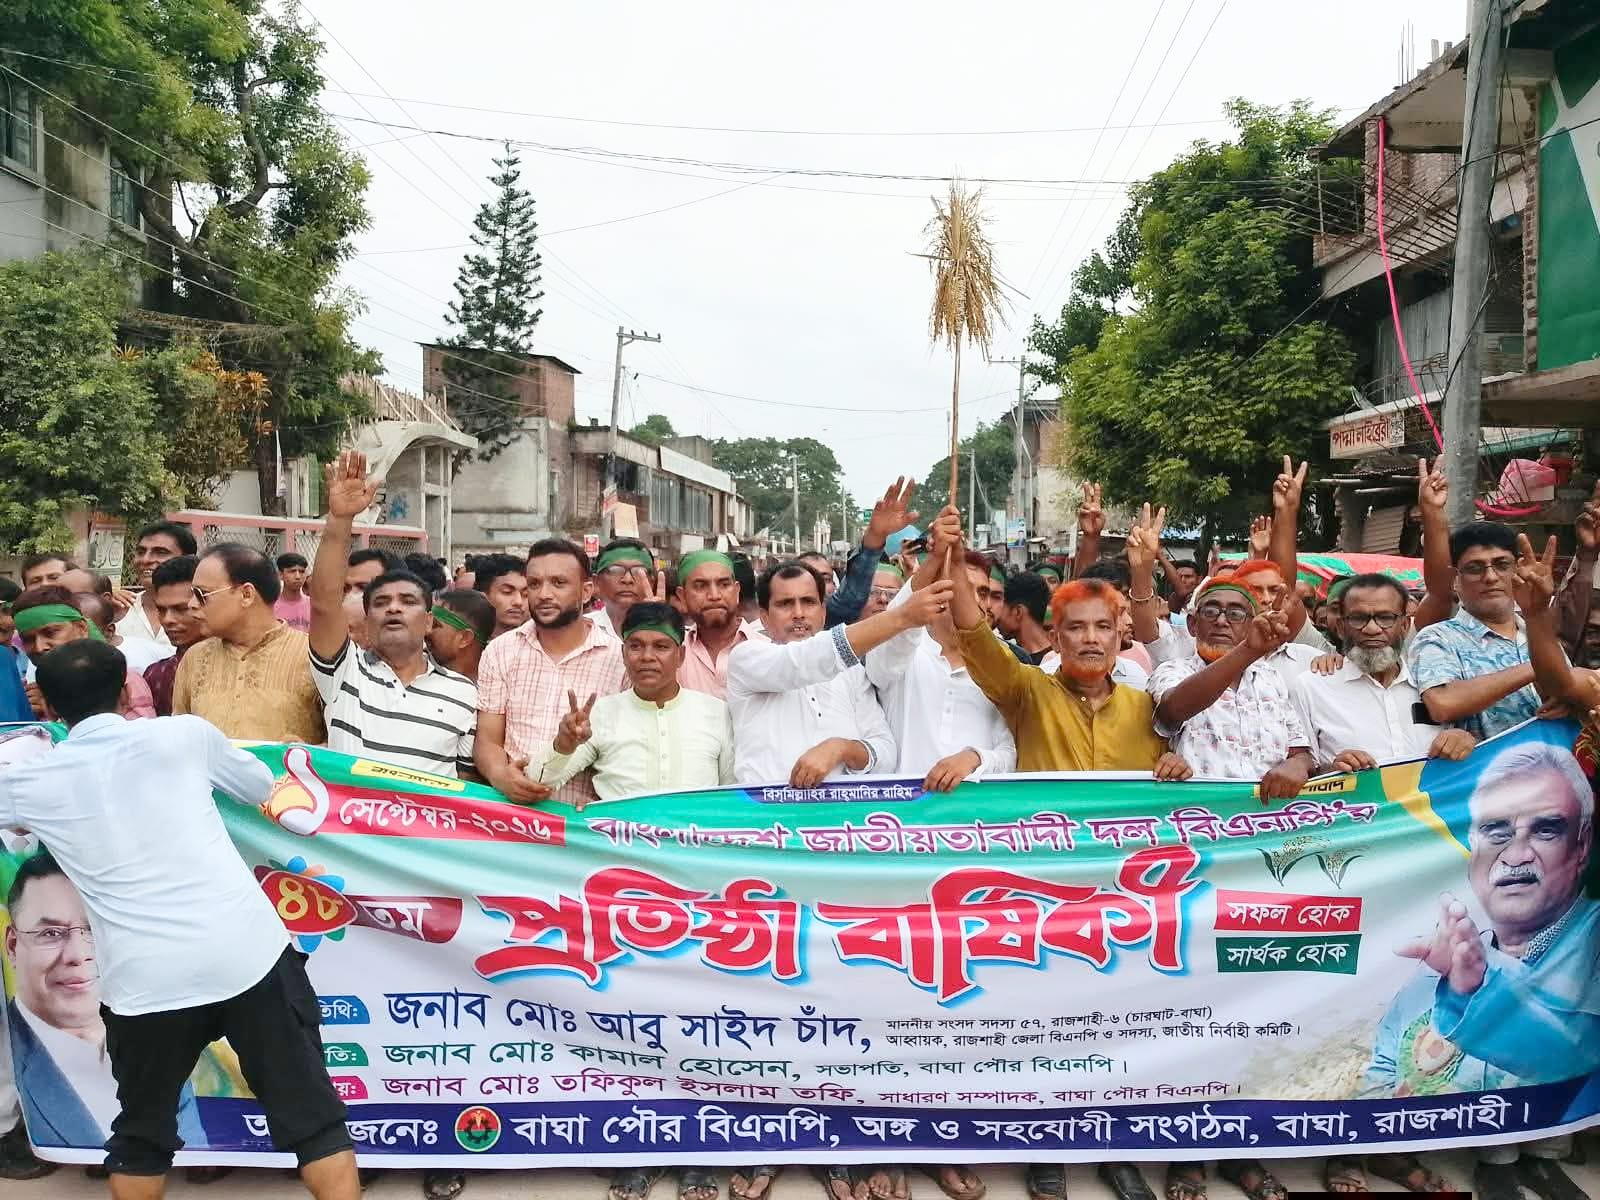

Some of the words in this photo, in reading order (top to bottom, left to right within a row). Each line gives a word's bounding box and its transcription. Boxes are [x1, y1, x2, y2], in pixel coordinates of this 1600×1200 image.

[798, 811, 1080, 854] জাতীয়তাবাদী
[1085, 816, 1160, 848] দল
[472, 866, 803, 986] প্রতিষ্ঠা
[1226, 902, 1292, 925] সফল
[1298, 903, 1355, 927] হোক
[1226, 940, 1292, 967] সার্থক
[1296, 942, 1350, 966] হোক
[384, 987, 492, 1029] জনাব
[506, 999, 577, 1032] মোঃ
[587, 1010, 668, 1053] আবু
[678, 1005, 782, 1050] সাইদ
[792, 1005, 871, 1053] চাঁদ,
[886, 1017, 932, 1030] মাননীয়
[938, 1019, 976, 1030] সংসদ
[980, 1019, 1016, 1030] সদস্য
[952, 1032, 1005, 1046] রাজশাহী
[1012, 1033, 1043, 1045] জেলা
[1050, 1029, 1097, 1043] বিএনপি
[1103, 1031, 1112, 1040] ও
[1119, 1027, 1156, 1040] সদস্য,
[1162, 1022, 1204, 1038] জাতীয়
[1209, 1021, 1250, 1039] নির্বাহী
[382, 1041, 476, 1066] জনাব
[489, 1039, 554, 1063] মোঃ
[564, 1043, 667, 1069] কামাল
[680, 1057, 800, 1082] হোসেন,
[816, 1060, 909, 1077] সভাপতি,
[919, 1061, 965, 1075] বাঘা
[974, 1057, 1023, 1073] পৌর
[381, 1076, 467, 1097] জনাব
[480, 1074, 540, 1094] মোঃ
[552, 1068, 667, 1098] তফিকুল
[676, 1076, 779, 1099] ইসলাম
[790, 1082, 864, 1104] তফি,
[878, 1090, 950, 1104] সাধারণ
[956, 1090, 1044, 1105] সম্পাদক,
[1052, 1089, 1096, 1102] বাঘা
[1104, 1085, 1149, 1100] পৌর
[510, 1113, 591, 1145] বাঘা
[602, 1106, 687, 1144] পৌর
[695, 1104, 840, 1148] বিএনপি,
[852, 1117, 920, 1142] অঙ্গ
[931, 1120, 960, 1140] ও
[972, 1111, 1117, 1143] সহযোগী
[1126, 1104, 1259, 1144] সংগঠন,
[1273, 1111, 1358, 1142] বাঘা,
